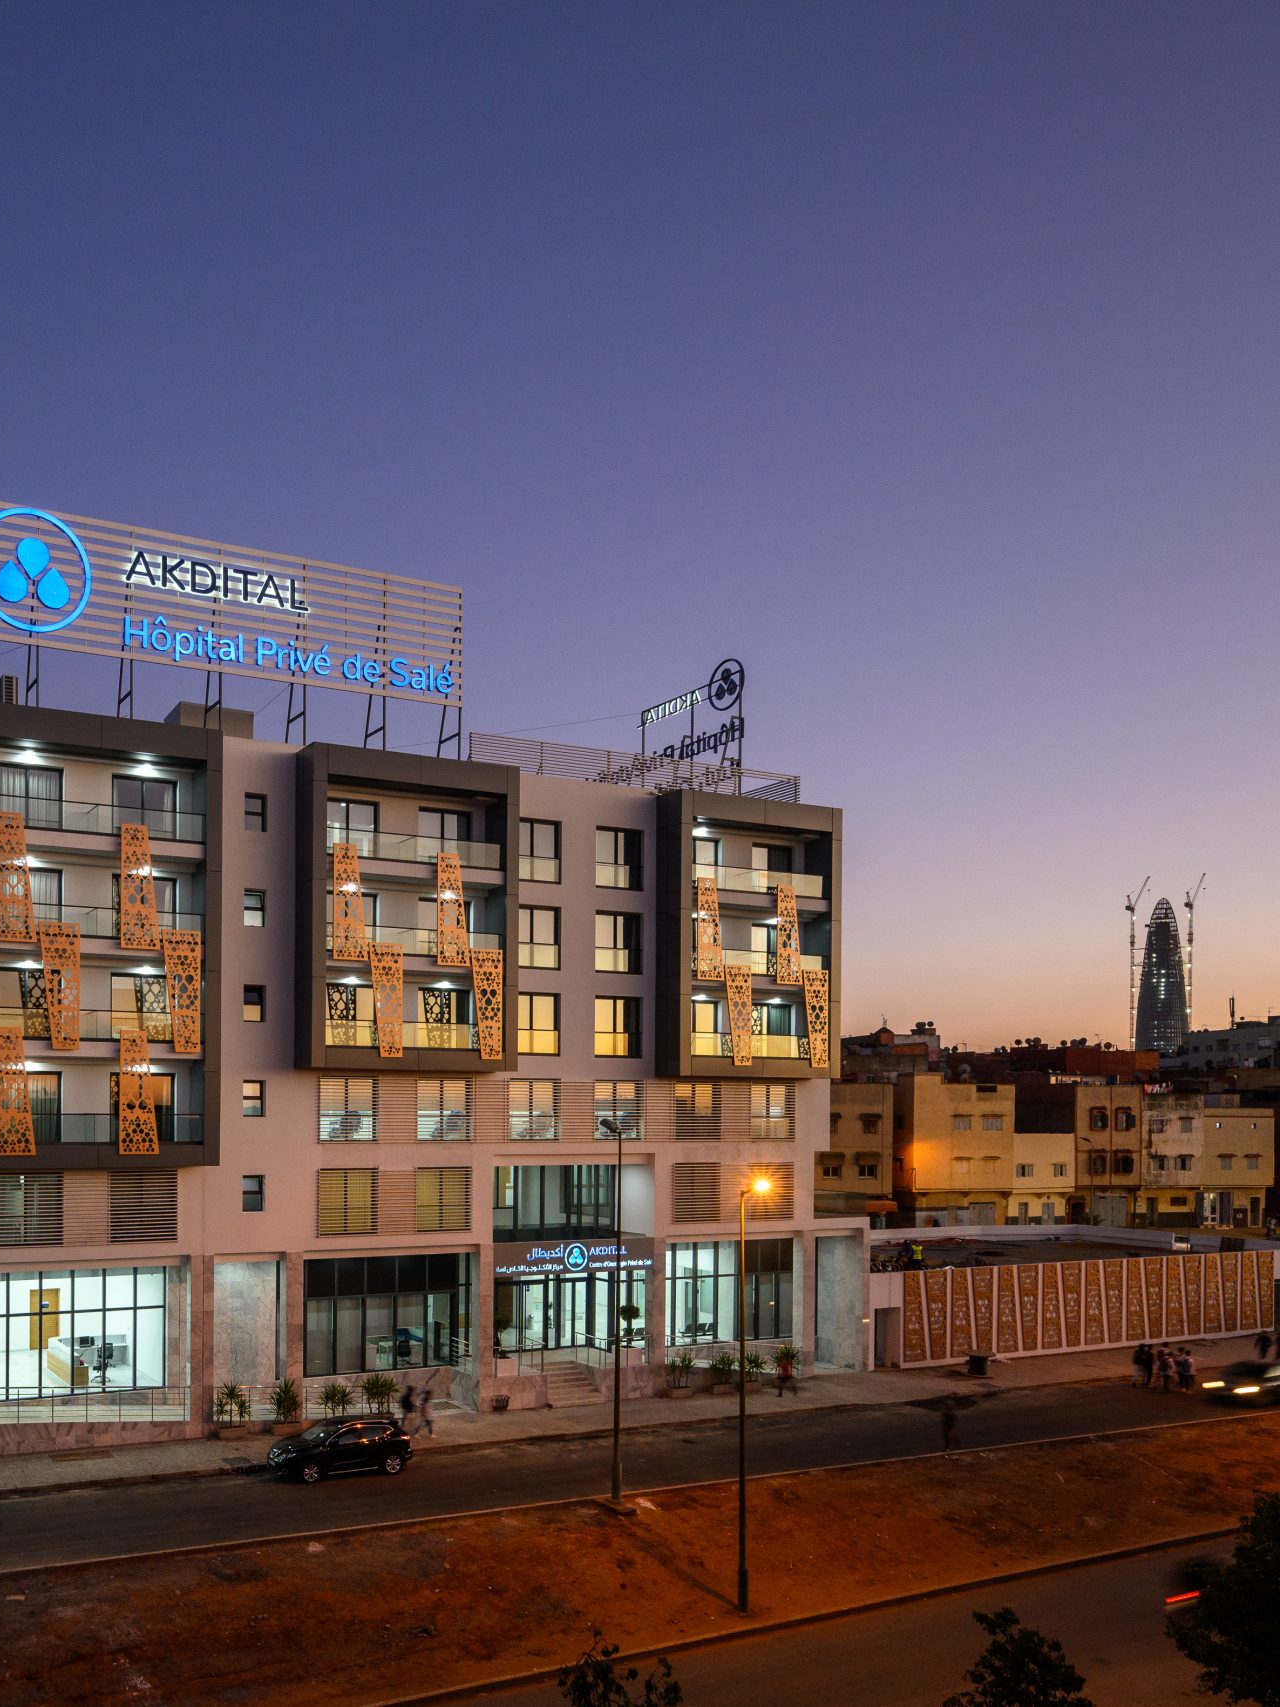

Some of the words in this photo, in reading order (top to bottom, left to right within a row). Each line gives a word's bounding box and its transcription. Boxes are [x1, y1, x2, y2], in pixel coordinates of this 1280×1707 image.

[124, 550, 310, 613] AKDITAL
[123, 614, 244, 663] Hôpital
[256, 635, 331, 676] Privé
[343, 652, 381, 683] de
[390, 656, 453, 694] Salé
